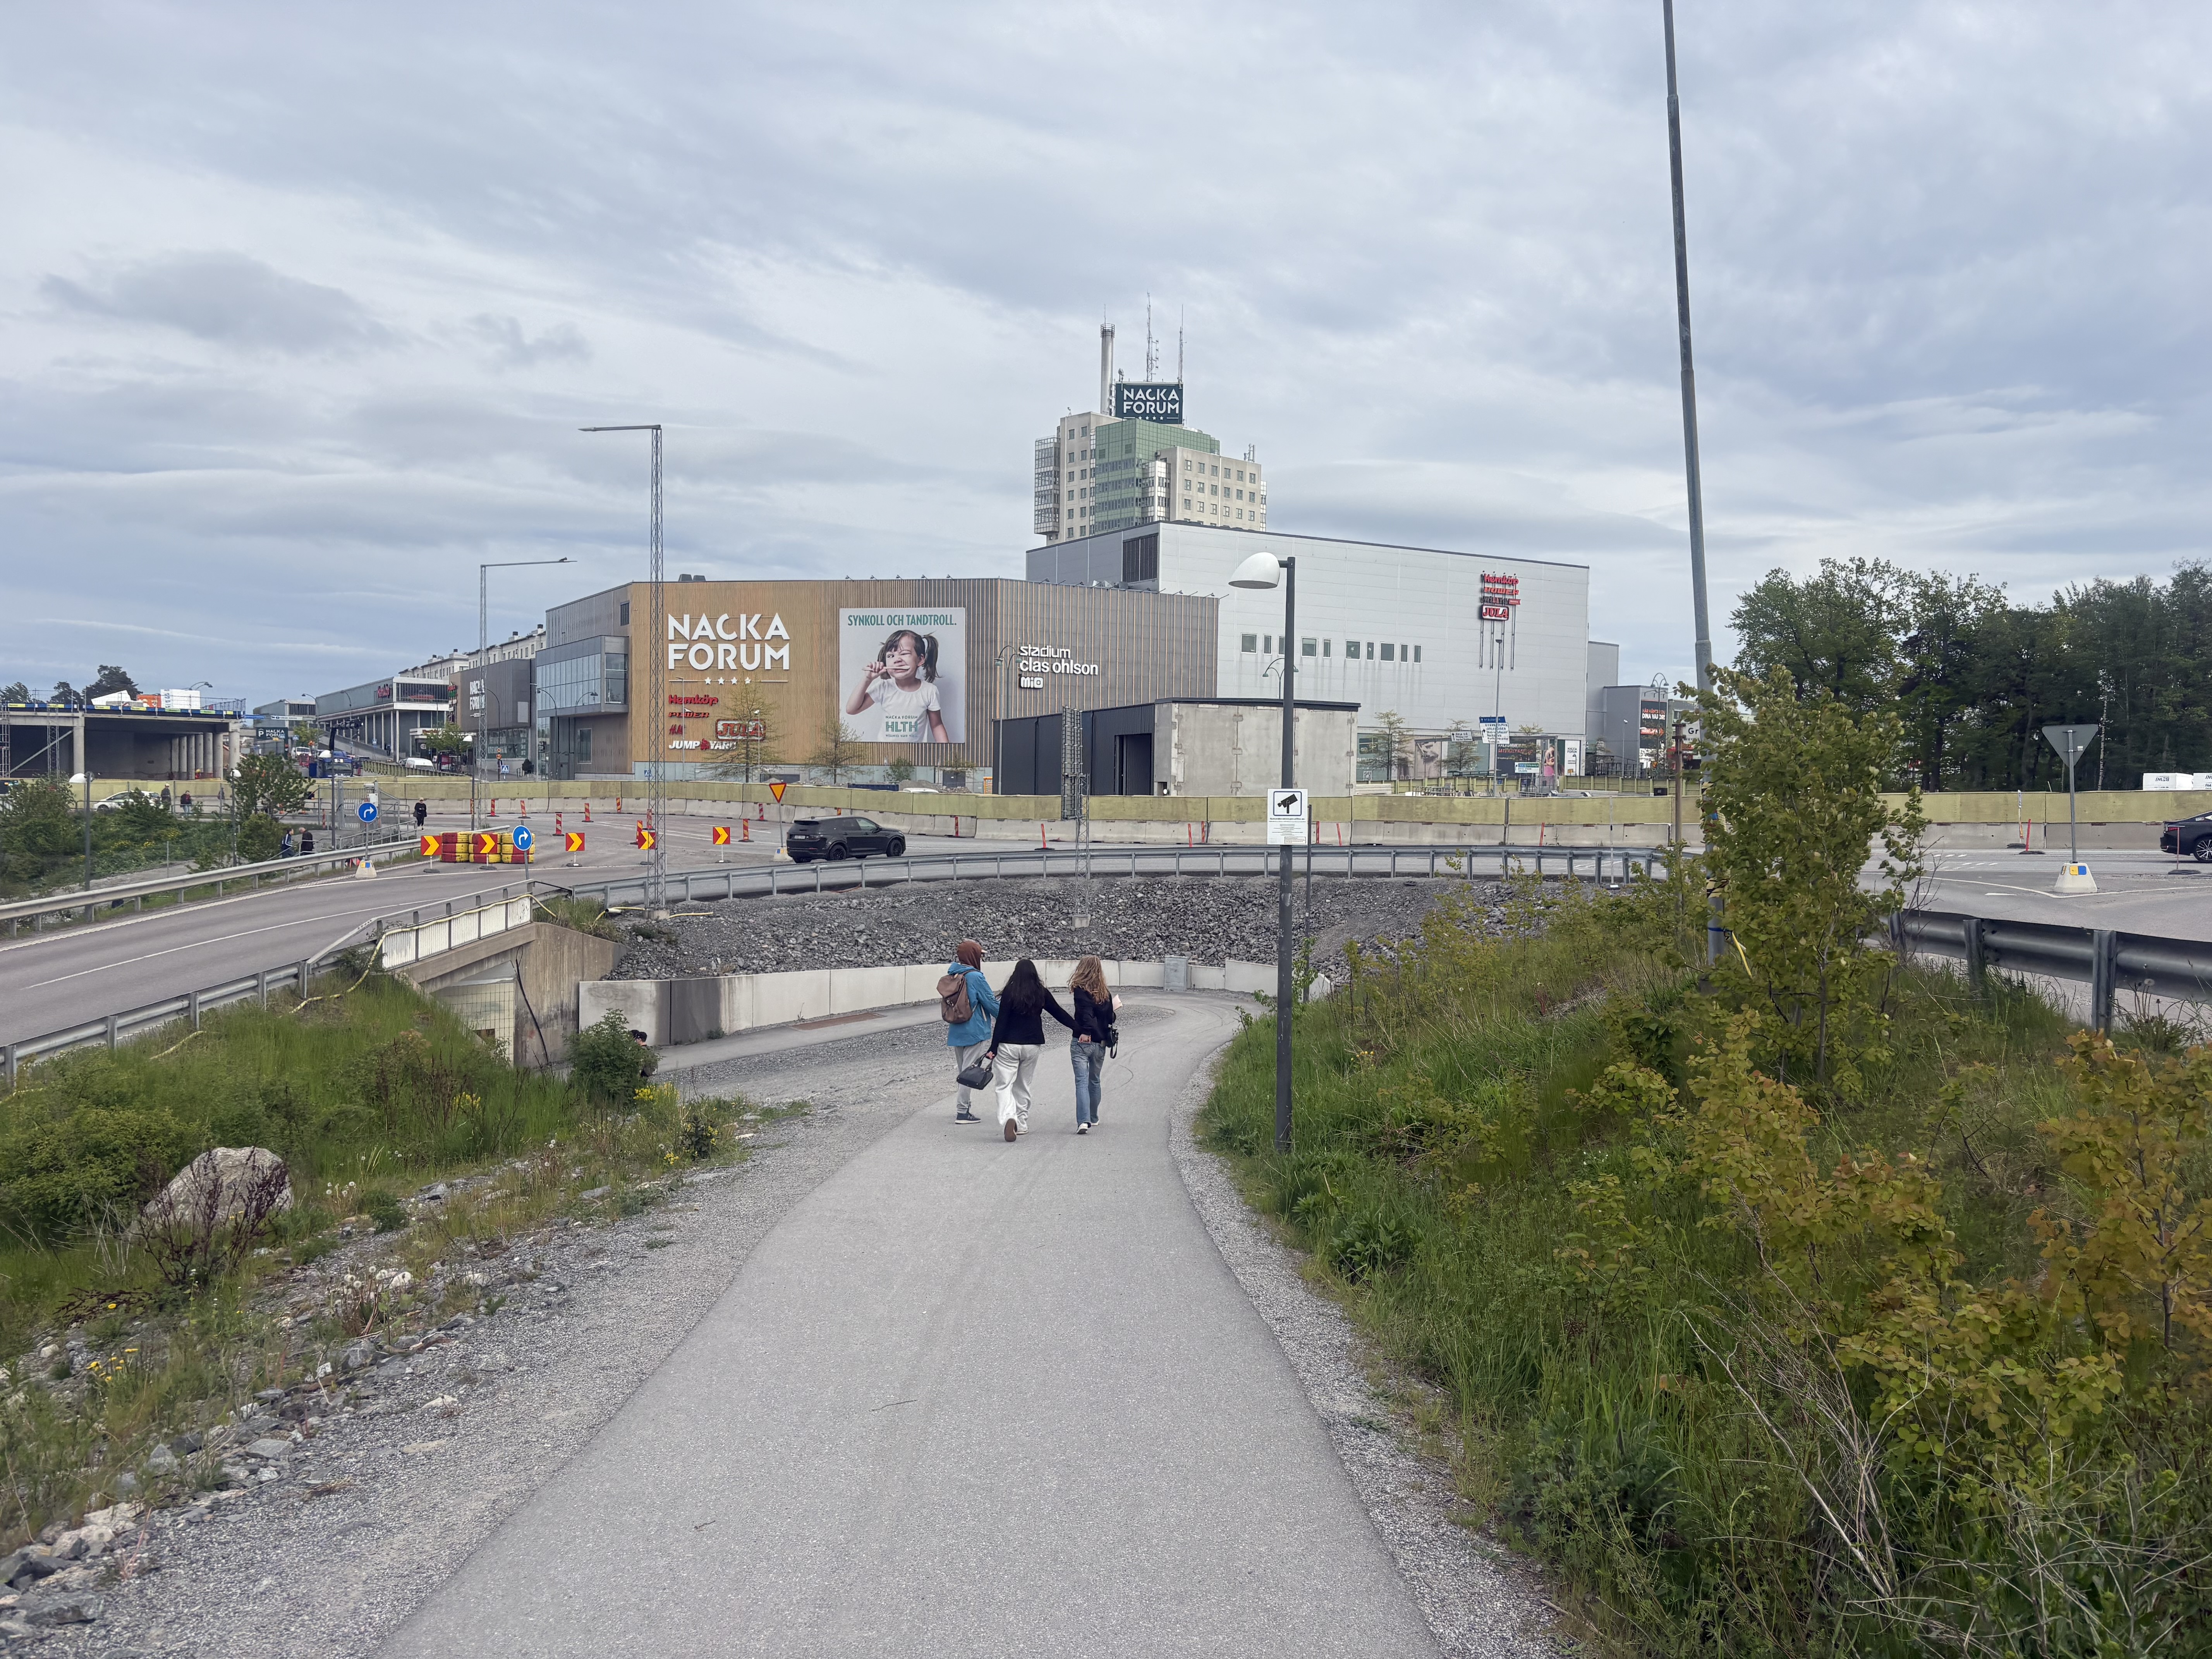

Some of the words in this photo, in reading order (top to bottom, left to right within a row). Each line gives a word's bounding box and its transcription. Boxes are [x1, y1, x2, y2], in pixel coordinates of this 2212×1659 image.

[1123, 388, 1179, 400] NACKA
[1123, 402, 1179, 414] FORUM
[1483, 608, 1508, 618] JULA
[848, 615, 885, 626] SYNKOLL
[887, 615, 904, 626] OCH
[906, 614, 957, 626] TANDTROLL.
[668, 613, 790, 641] NACKA
[668, 642, 790, 670] FORUM
[1020, 644, 1071, 658] stadium
[1020, 657, 1049, 673] clas
[1052, 659, 1098, 675] ohlson
[470, 679, 485, 695] NACA
[668, 694, 719, 706] Hemköp
[886, 721, 918, 732] HLTH
[669, 740, 701, 749] JUMP
